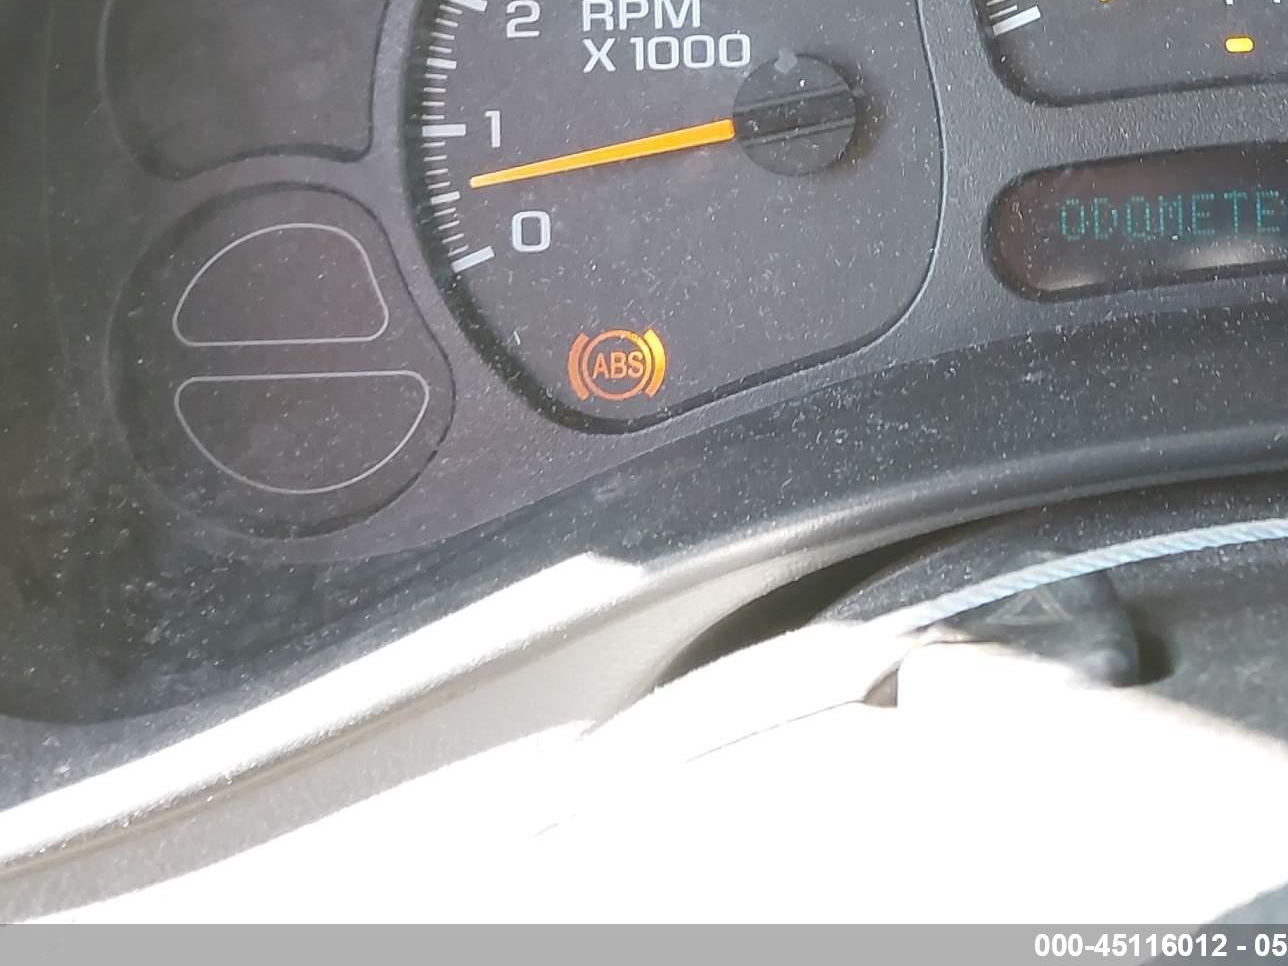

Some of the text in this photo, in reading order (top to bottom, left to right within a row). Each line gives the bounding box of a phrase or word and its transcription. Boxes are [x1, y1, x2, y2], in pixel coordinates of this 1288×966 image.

[506, 0, 541, 38] 2
[582, 34, 751, 73] X 1000
[484, 110, 501, 148] 1
[511, 210, 551, 253] 0
[592, 351, 643, 378] ABS
